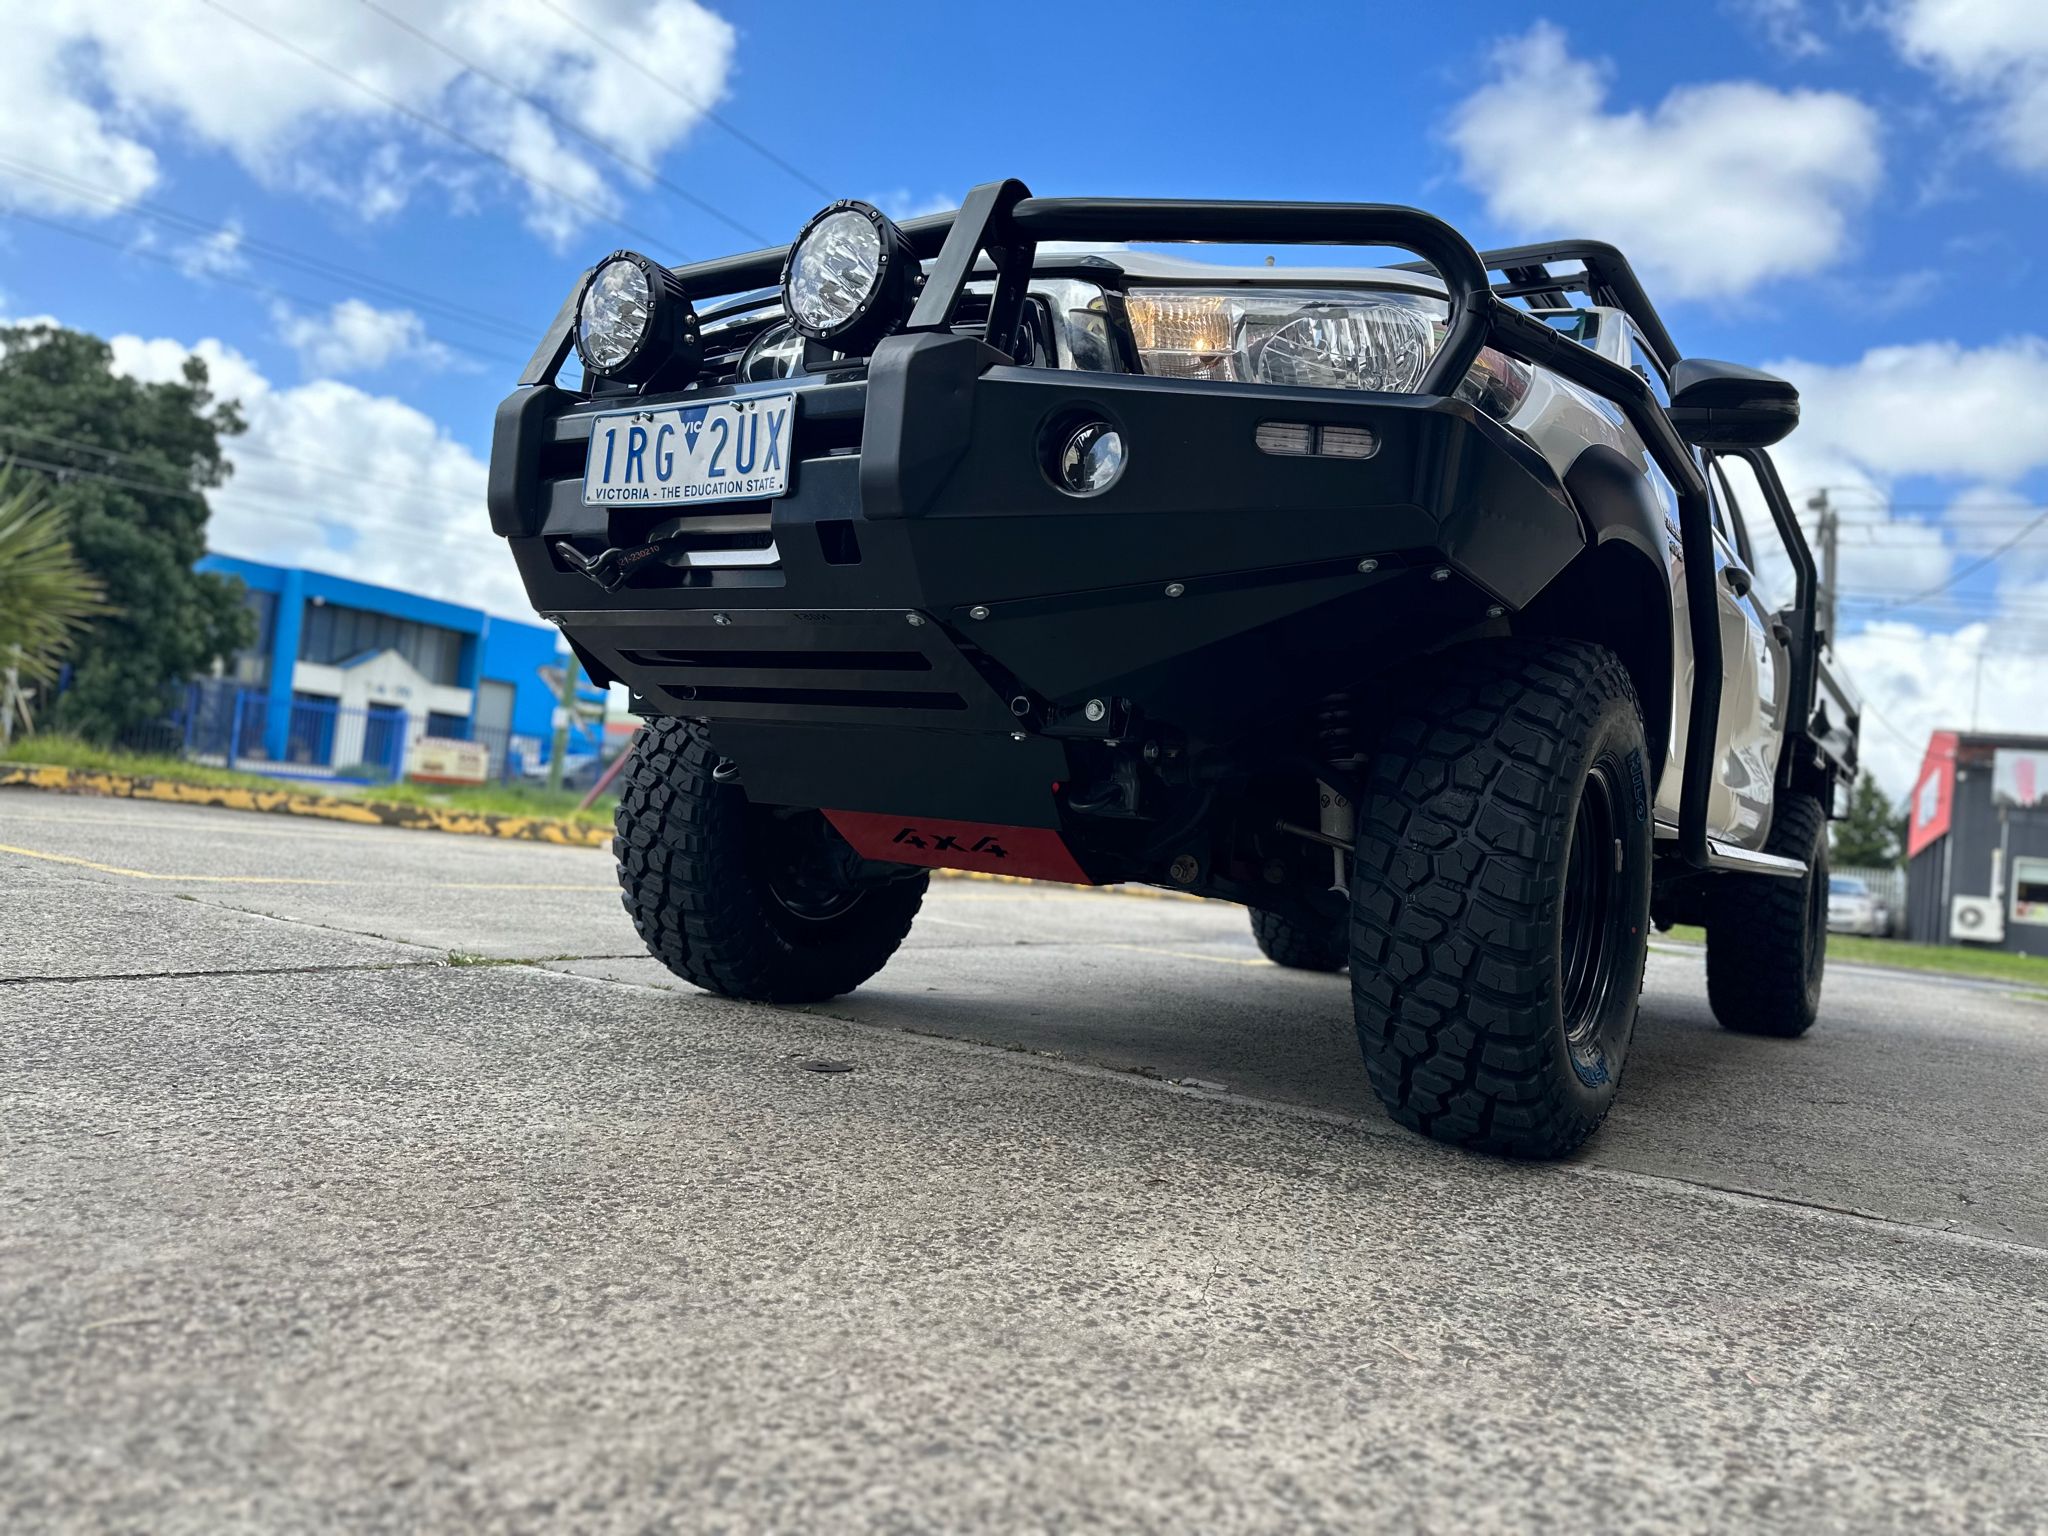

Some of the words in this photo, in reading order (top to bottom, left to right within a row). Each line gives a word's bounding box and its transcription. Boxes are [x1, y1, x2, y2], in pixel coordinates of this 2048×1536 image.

[603, 423, 674, 483] 1RG
[708, 409, 786, 478] 2UX
[596, 488, 649, 500] VICTORIA
[661, 486, 681, 498] THE
[684, 481, 743, 497] EDUCATION
[746, 477, 775, 492] STATE
